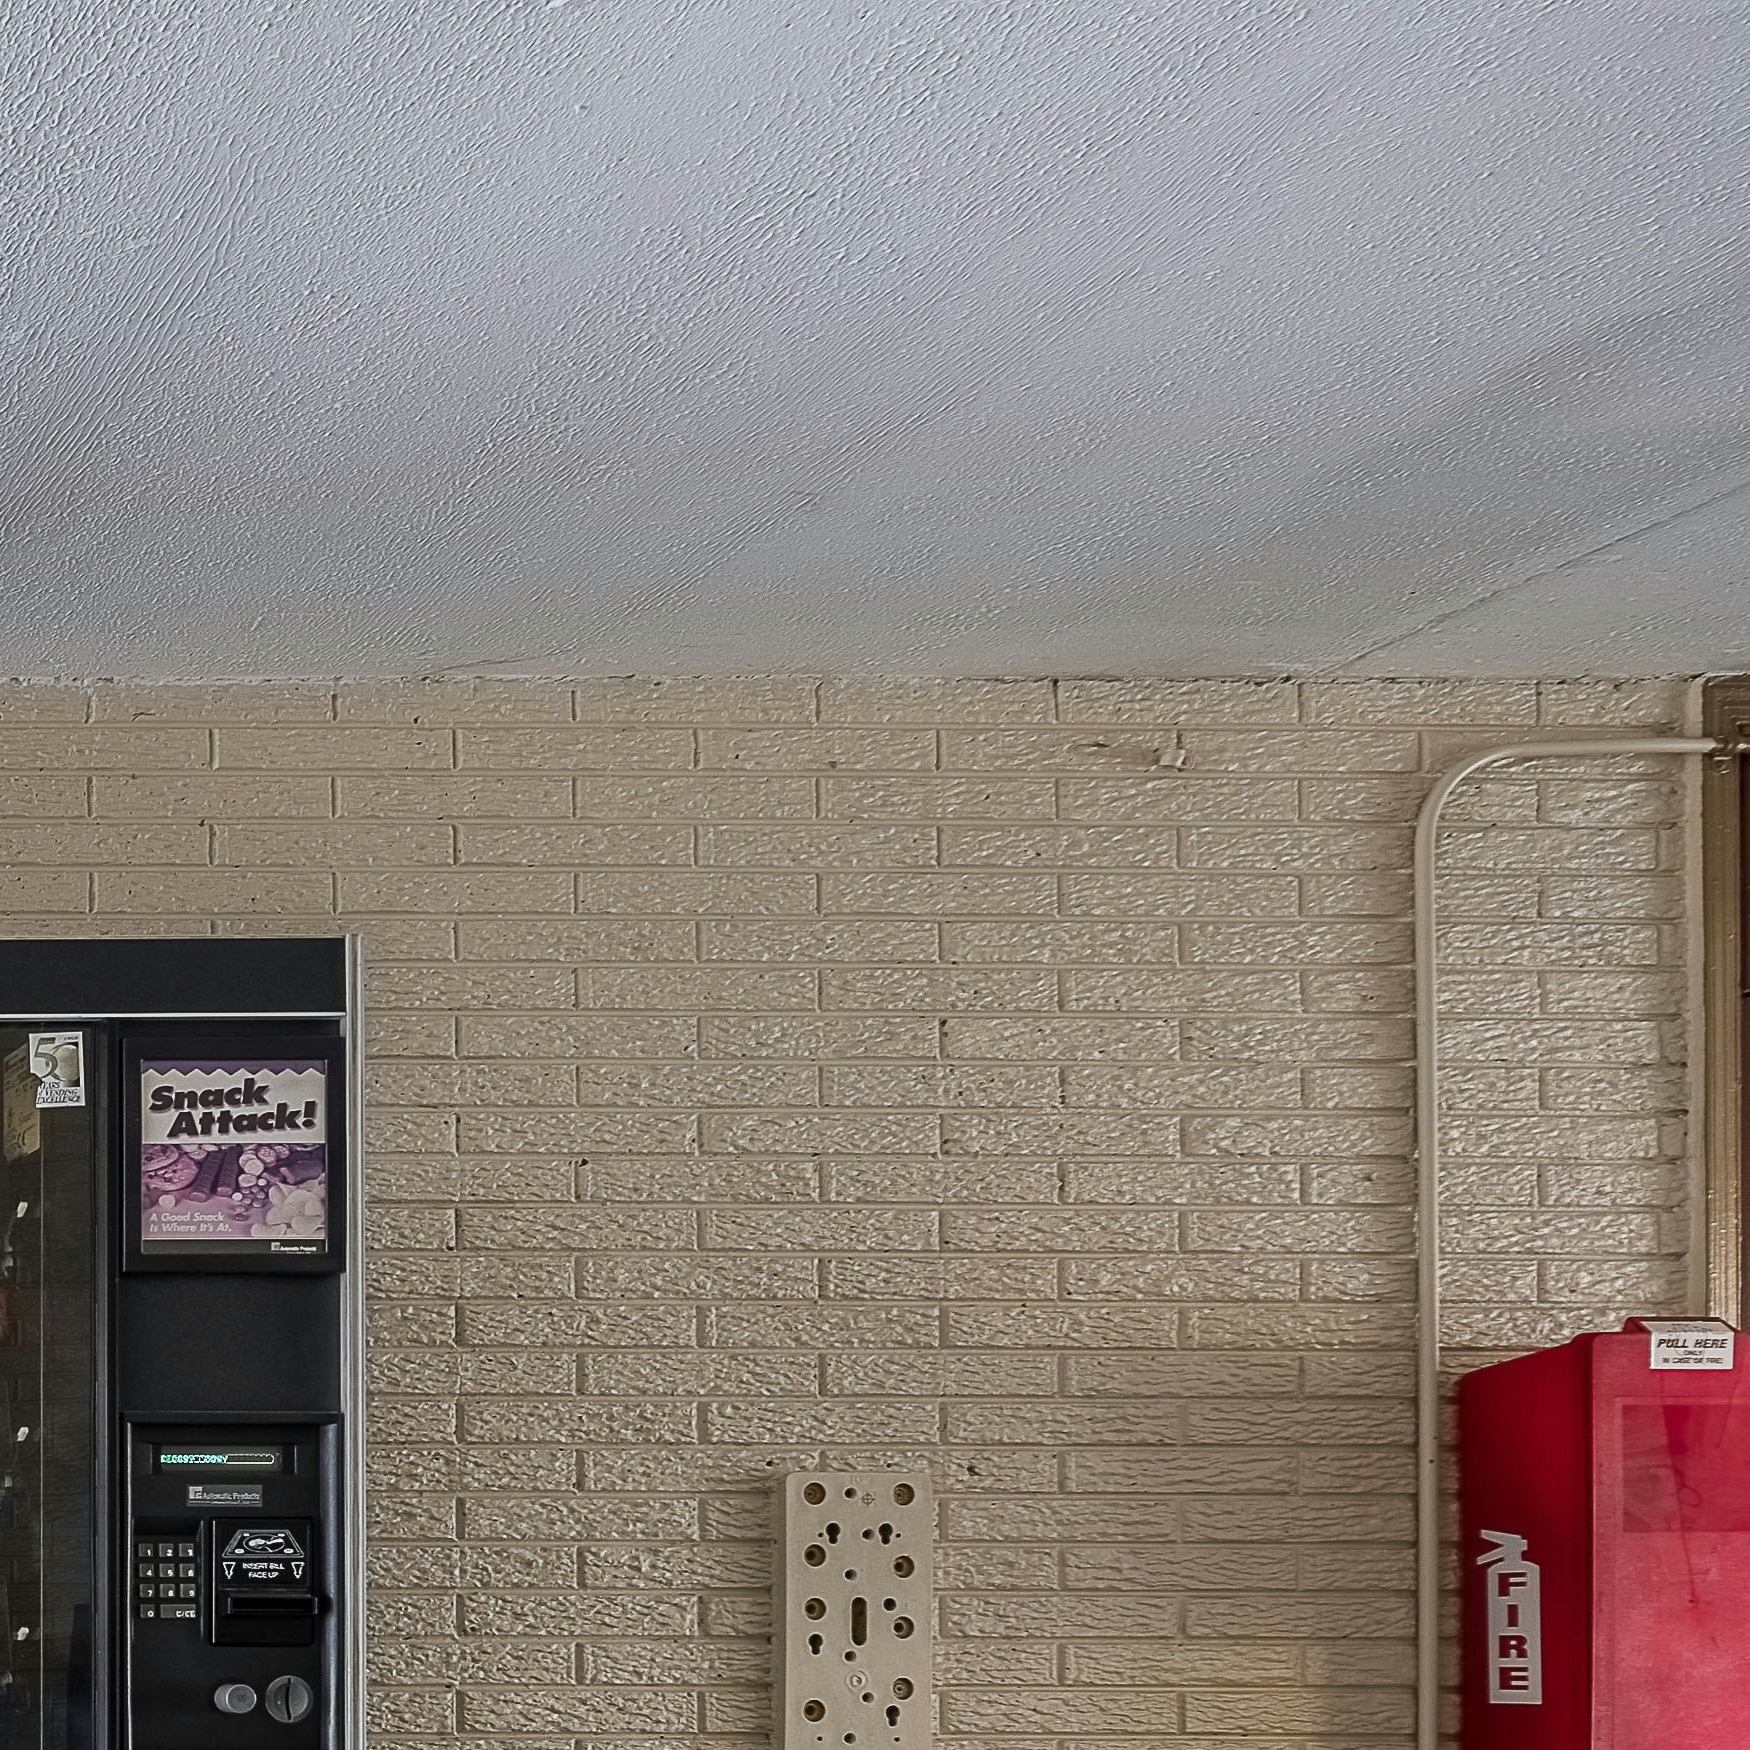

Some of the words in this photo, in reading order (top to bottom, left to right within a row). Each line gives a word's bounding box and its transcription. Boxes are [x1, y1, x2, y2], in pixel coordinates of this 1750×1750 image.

[148, 1077, 270, 1112] Snack
[165, 1099, 318, 1140] Attack!
[149, 1212, 159, 1222] A
[161, 1212, 191, 1223] Good
[192, 1211, 226, 1223] Snack
[149, 1224, 160, 1233] Is
[161, 1223, 198, 1233] Where
[1656, 1338, 1689, 1349] PULL
[1693, 1338, 1729, 1349] HERE
[147, 1549, 152, 1557] 1
[166, 1549, 173, 1557] 2
[146, 1569, 153, 1577] 4
[167, 1569, 174, 1577] 5
[248, 1571, 268, 1579] FACE
[147, 1589, 153, 1597] 7
[1498, 1570, 1530, 1692] FIRE
